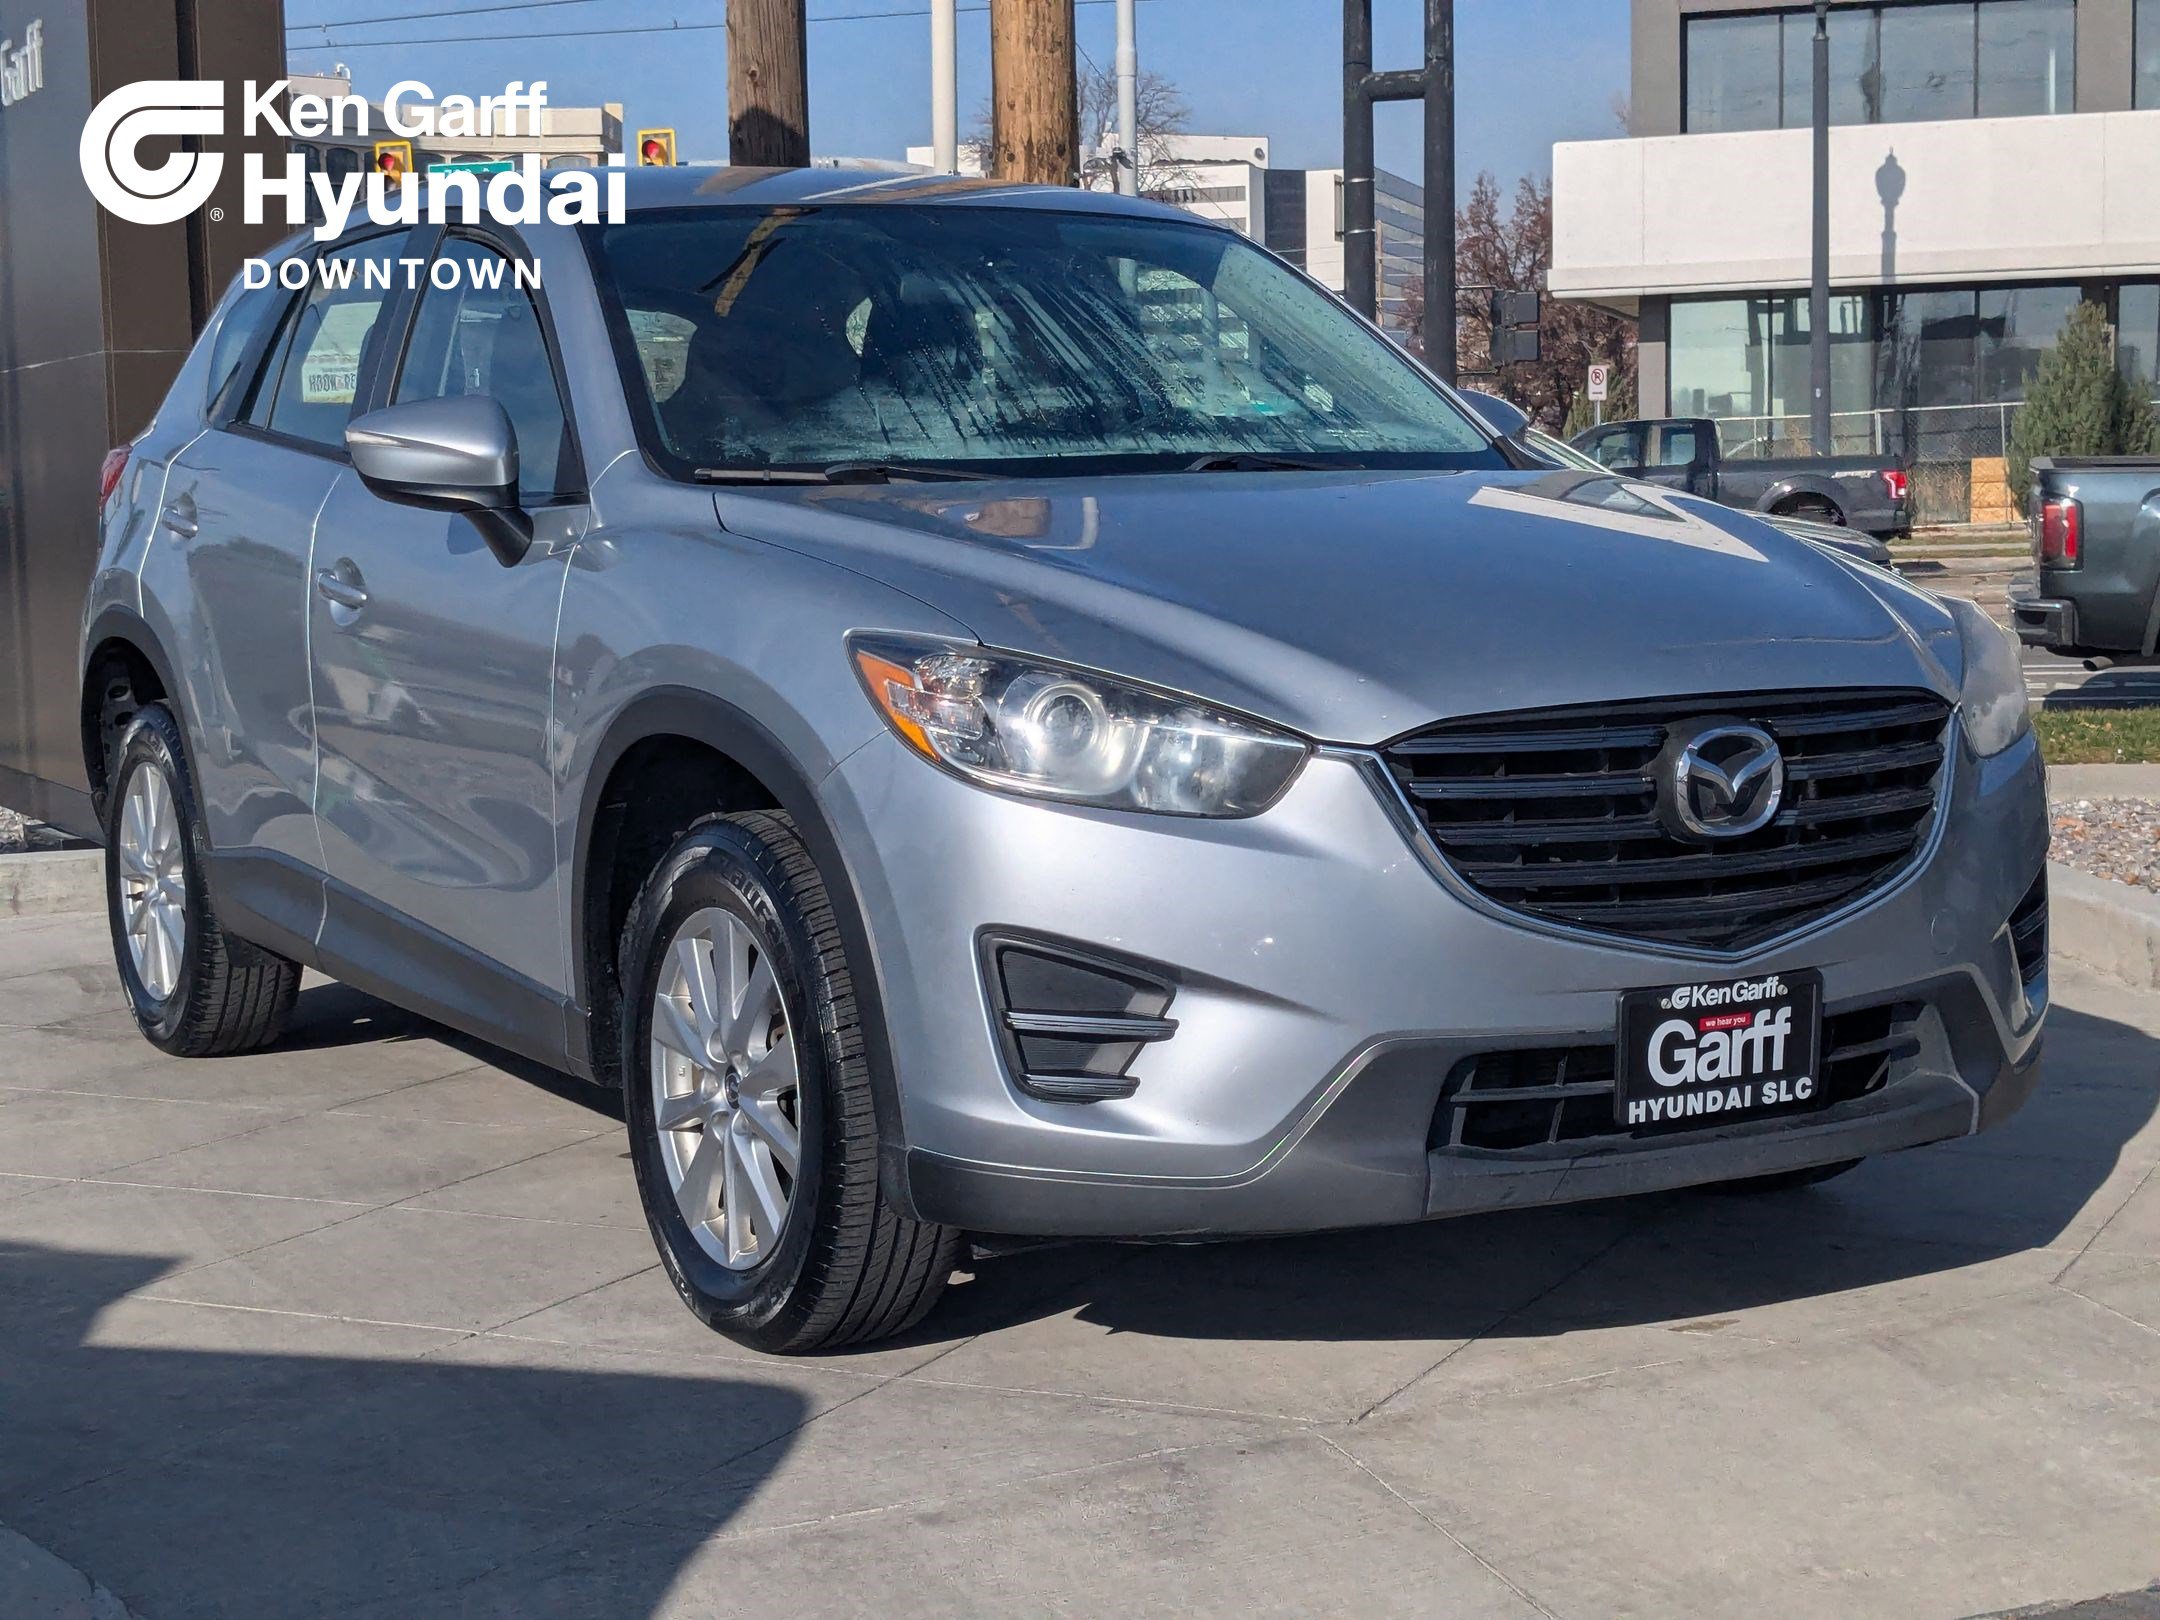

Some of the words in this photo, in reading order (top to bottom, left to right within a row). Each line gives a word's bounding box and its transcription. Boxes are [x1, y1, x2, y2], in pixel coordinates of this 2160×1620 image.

[1691, 987, 1730, 1008] Ken
[1732, 976, 1779, 1003] Garff
[1705, 1017, 1716, 1027] we
[1717, 1015, 1732, 1026] hear
[1733, 1015, 1746, 1026] you
[1647, 1006, 1792, 1087] Garff
[1628, 1085, 1751, 1125] HYUNDAI
[1761, 1076, 1813, 1105] SLC
